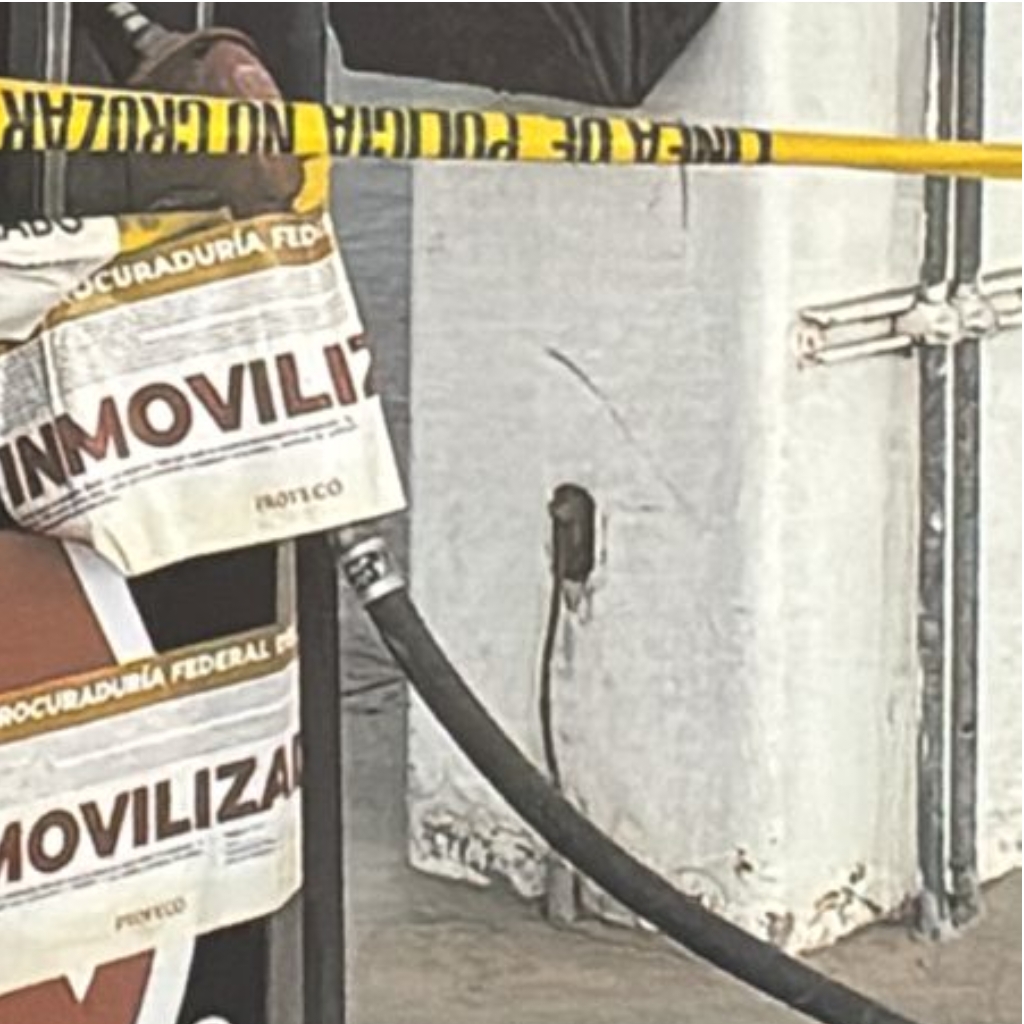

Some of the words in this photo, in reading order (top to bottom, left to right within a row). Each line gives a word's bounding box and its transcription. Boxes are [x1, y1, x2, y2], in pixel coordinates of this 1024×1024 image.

[1, 88, 211, 153] CRUZAR
[228, 98, 296, 155] NO
[322, 104, 518, 160] POLICIA
[552, 115, 611, 162] DE
[619, 117, 771, 165] LINEA
[69, 226, 267, 300] OCURADURÍA
[170, 640, 272, 685] FEDERAL
